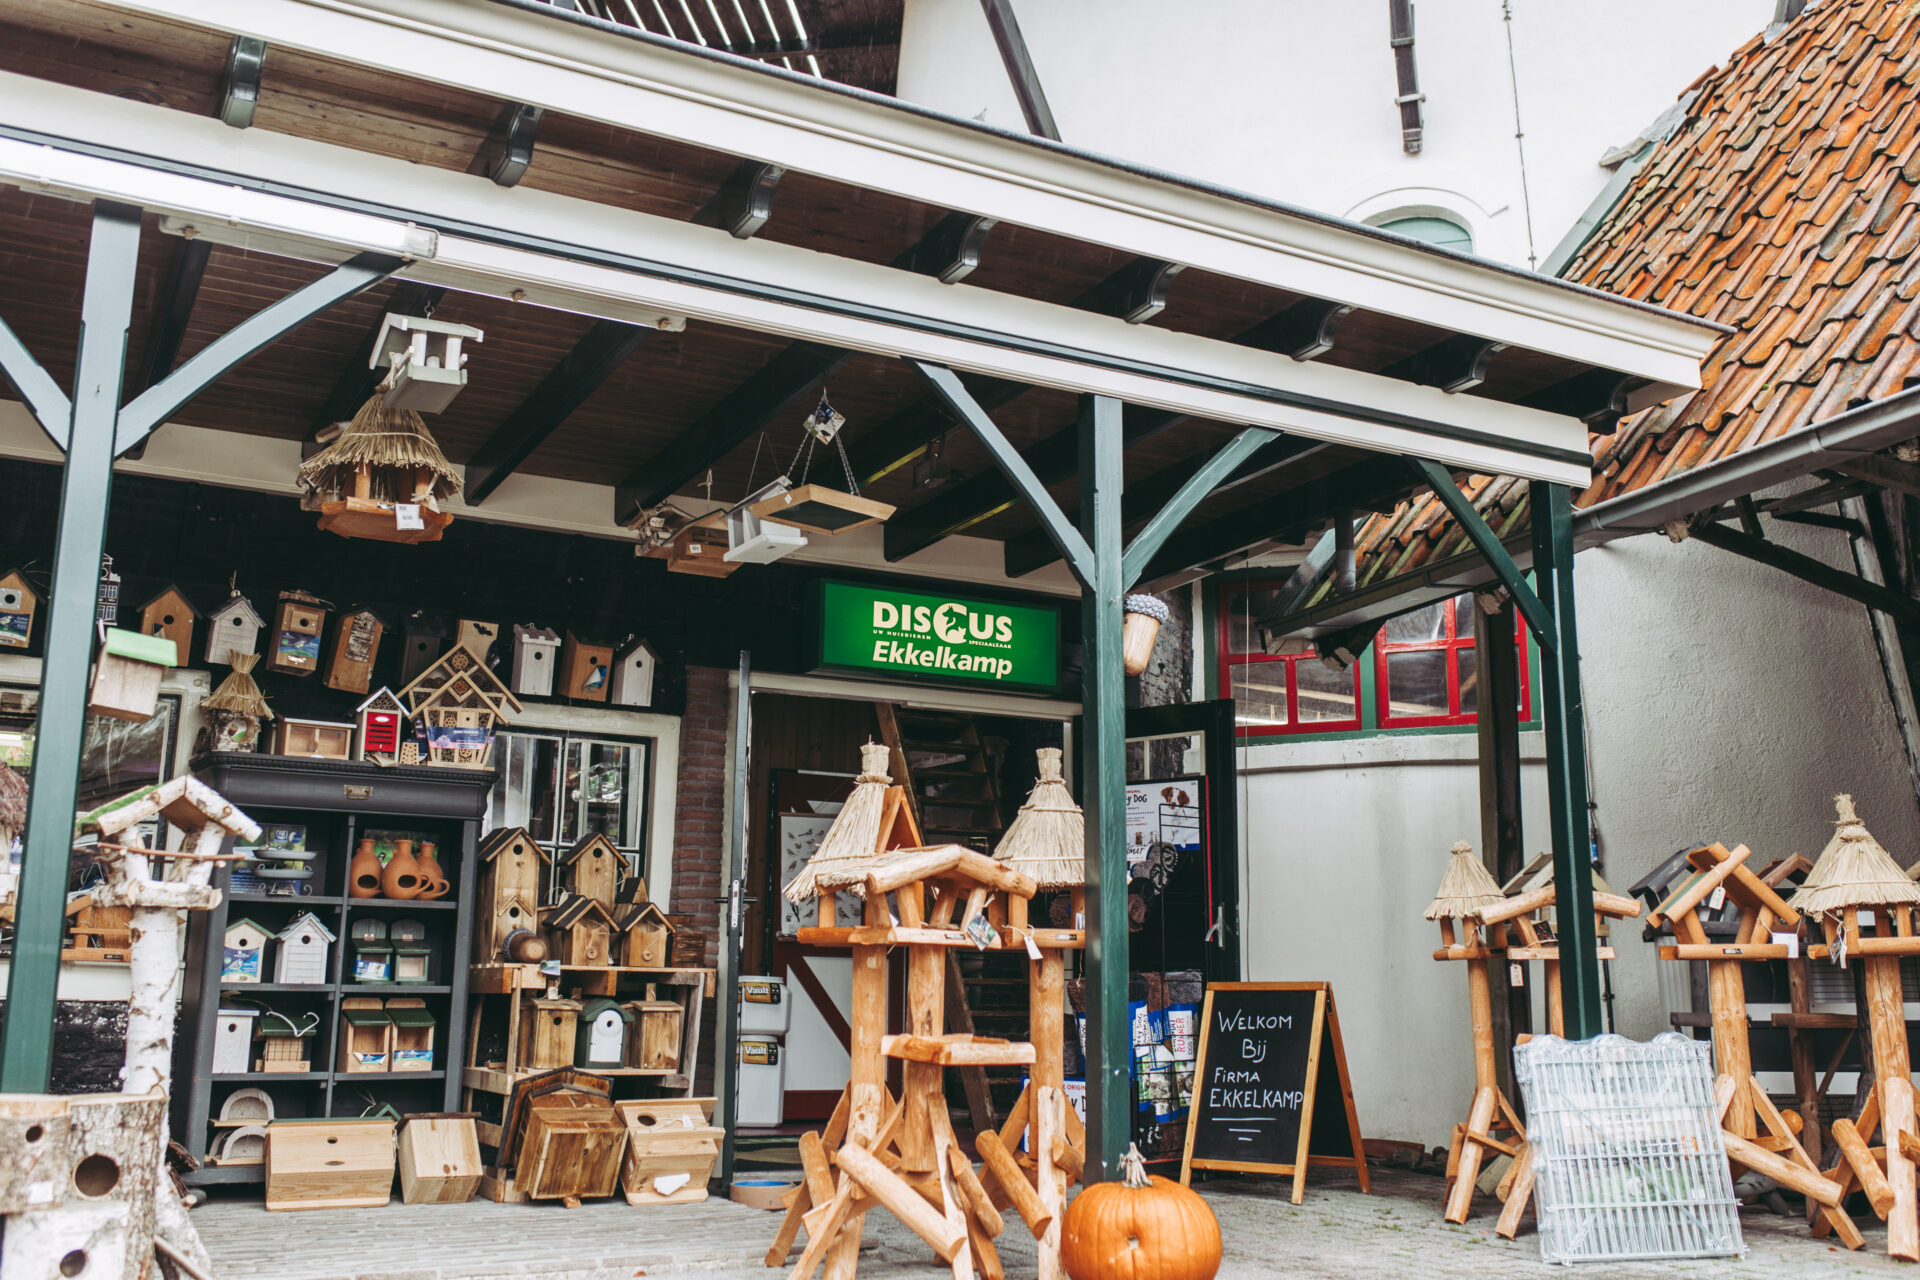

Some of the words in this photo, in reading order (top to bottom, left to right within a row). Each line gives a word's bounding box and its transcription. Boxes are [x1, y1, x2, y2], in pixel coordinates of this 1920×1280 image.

[873, 600, 1013, 645] DISCUS
[872, 640, 1013, 679] Ekkelkamp
[746, 986, 769, 995] Vault
[1218, 1008, 1292, 1033] WELKOM
[744, 1045, 767, 1056] Vault
[1209, 1088, 1304, 1111] EKKELKAMP
